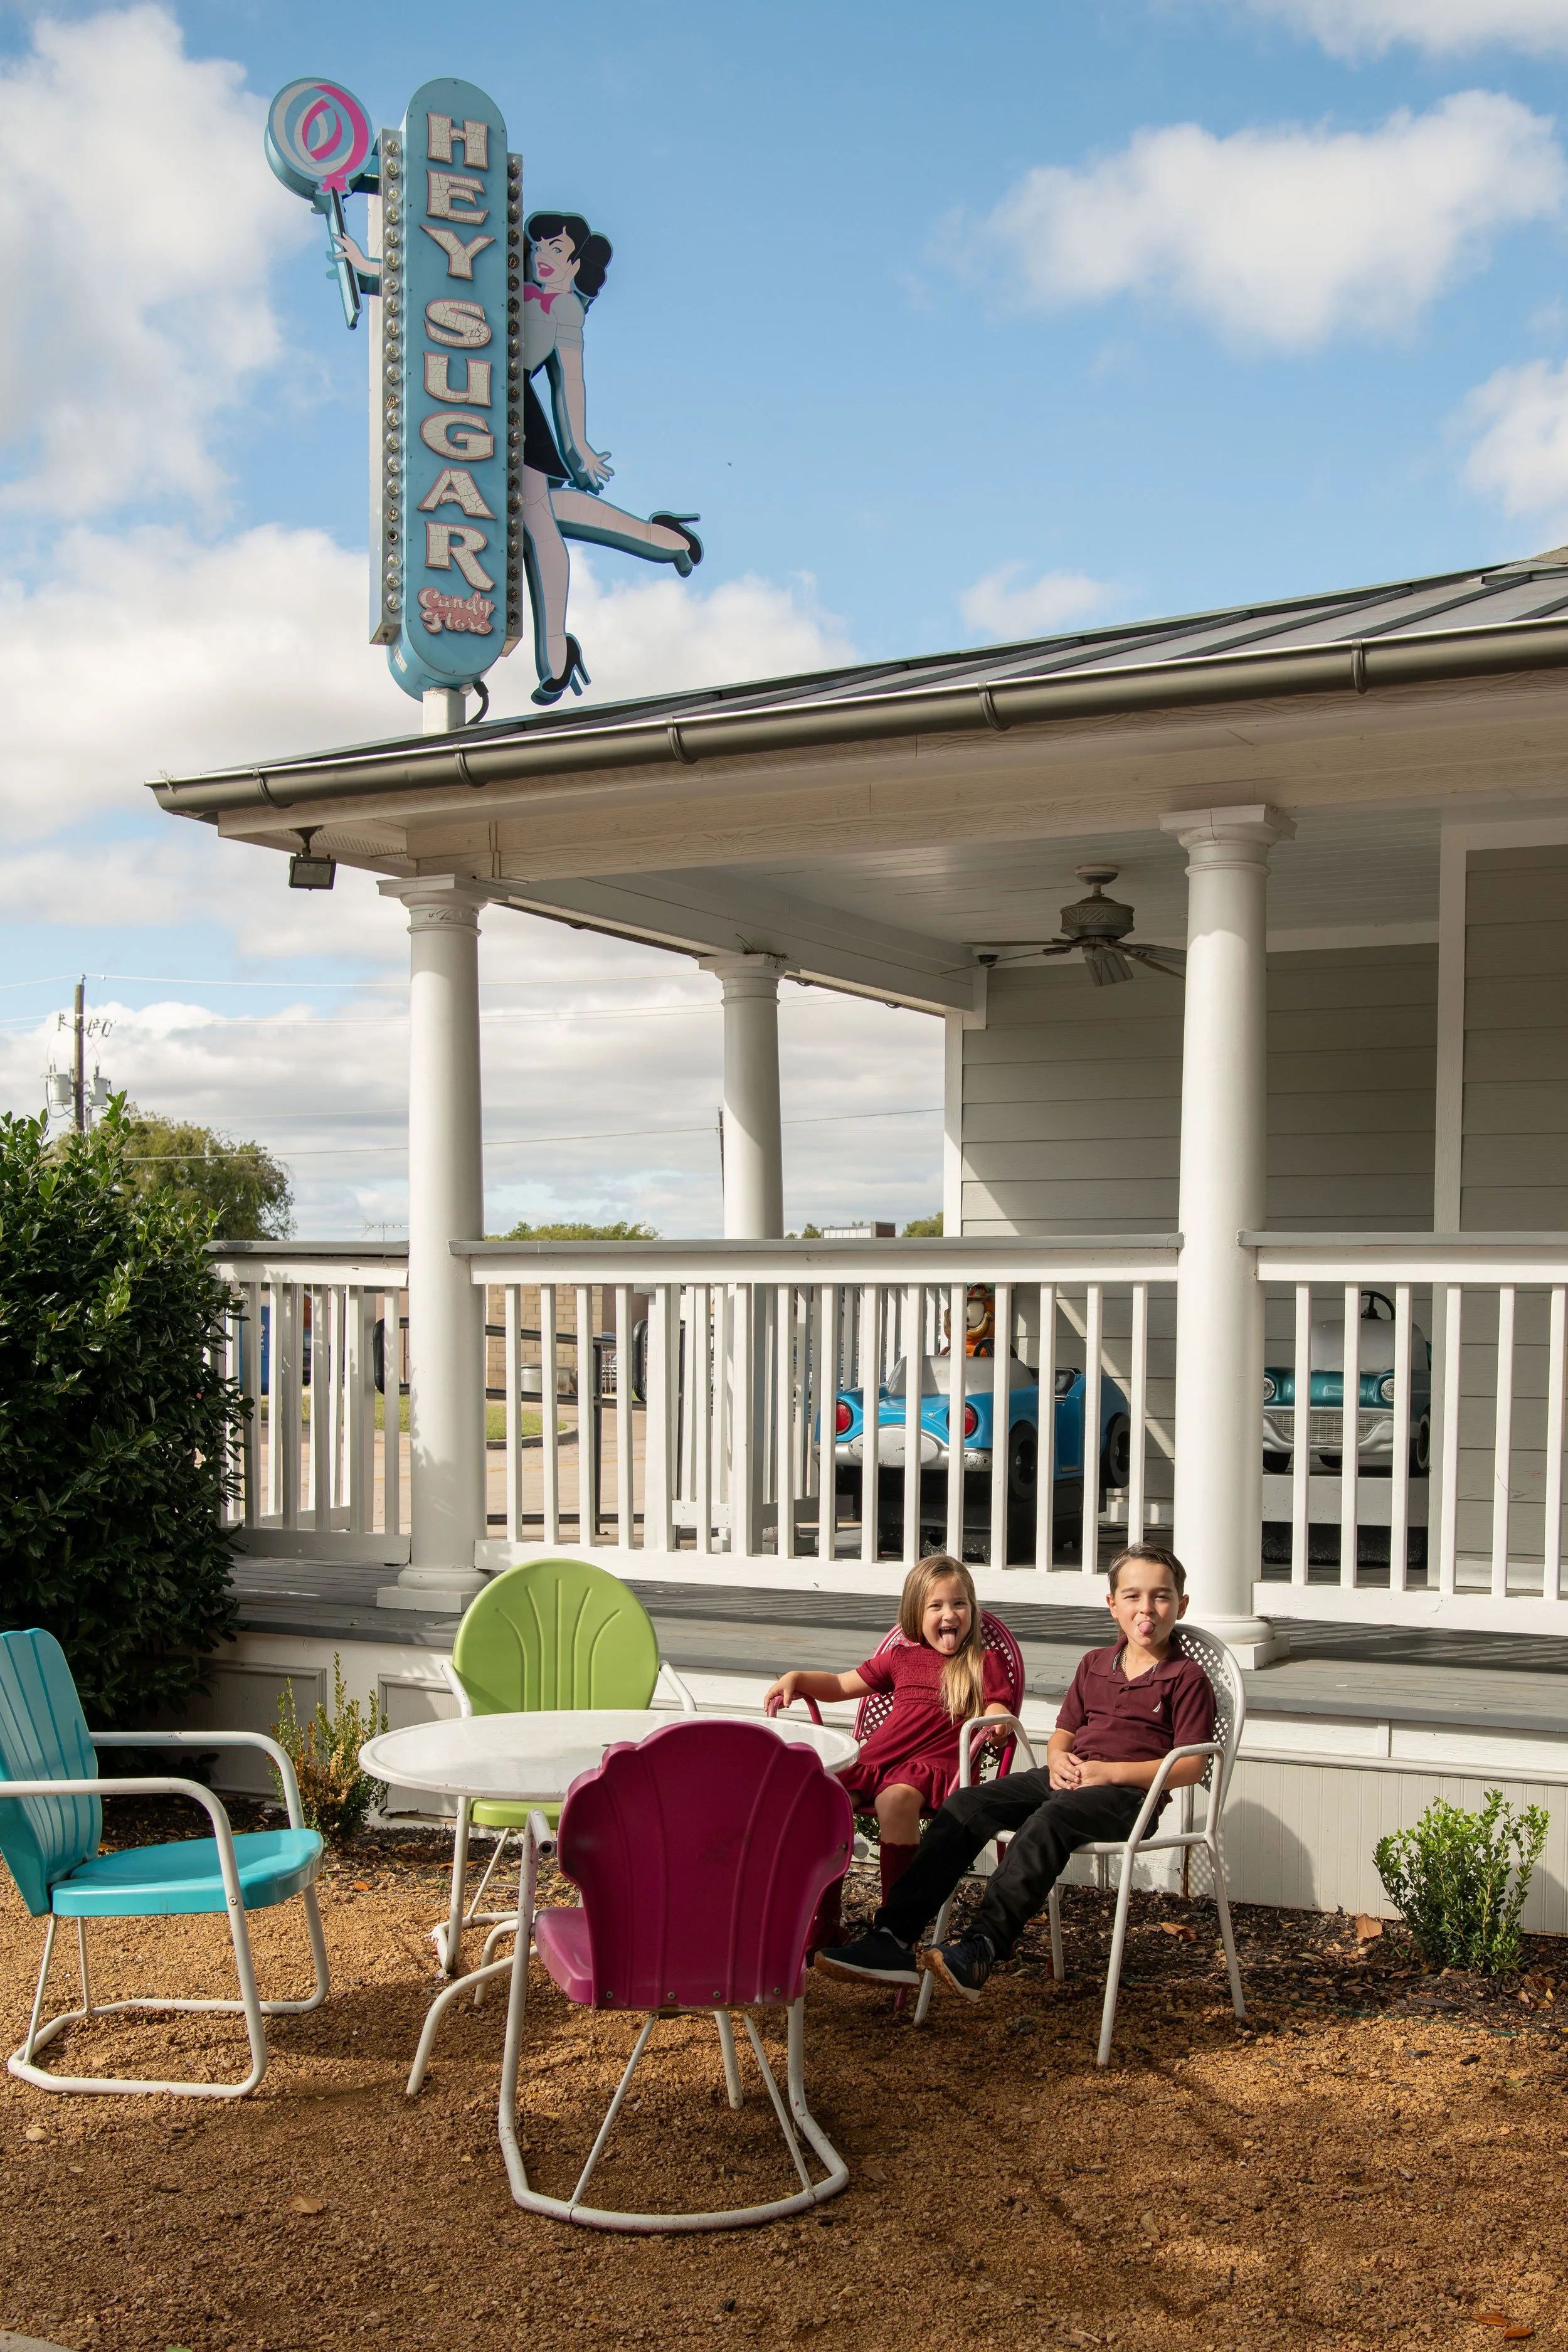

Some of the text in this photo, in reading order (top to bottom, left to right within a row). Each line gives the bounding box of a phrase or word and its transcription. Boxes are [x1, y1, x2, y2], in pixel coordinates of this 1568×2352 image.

[417, 112, 496, 591] HEY SUGAR
[420, 589, 494, 618] Candy
[422, 611, 492, 632] Store
